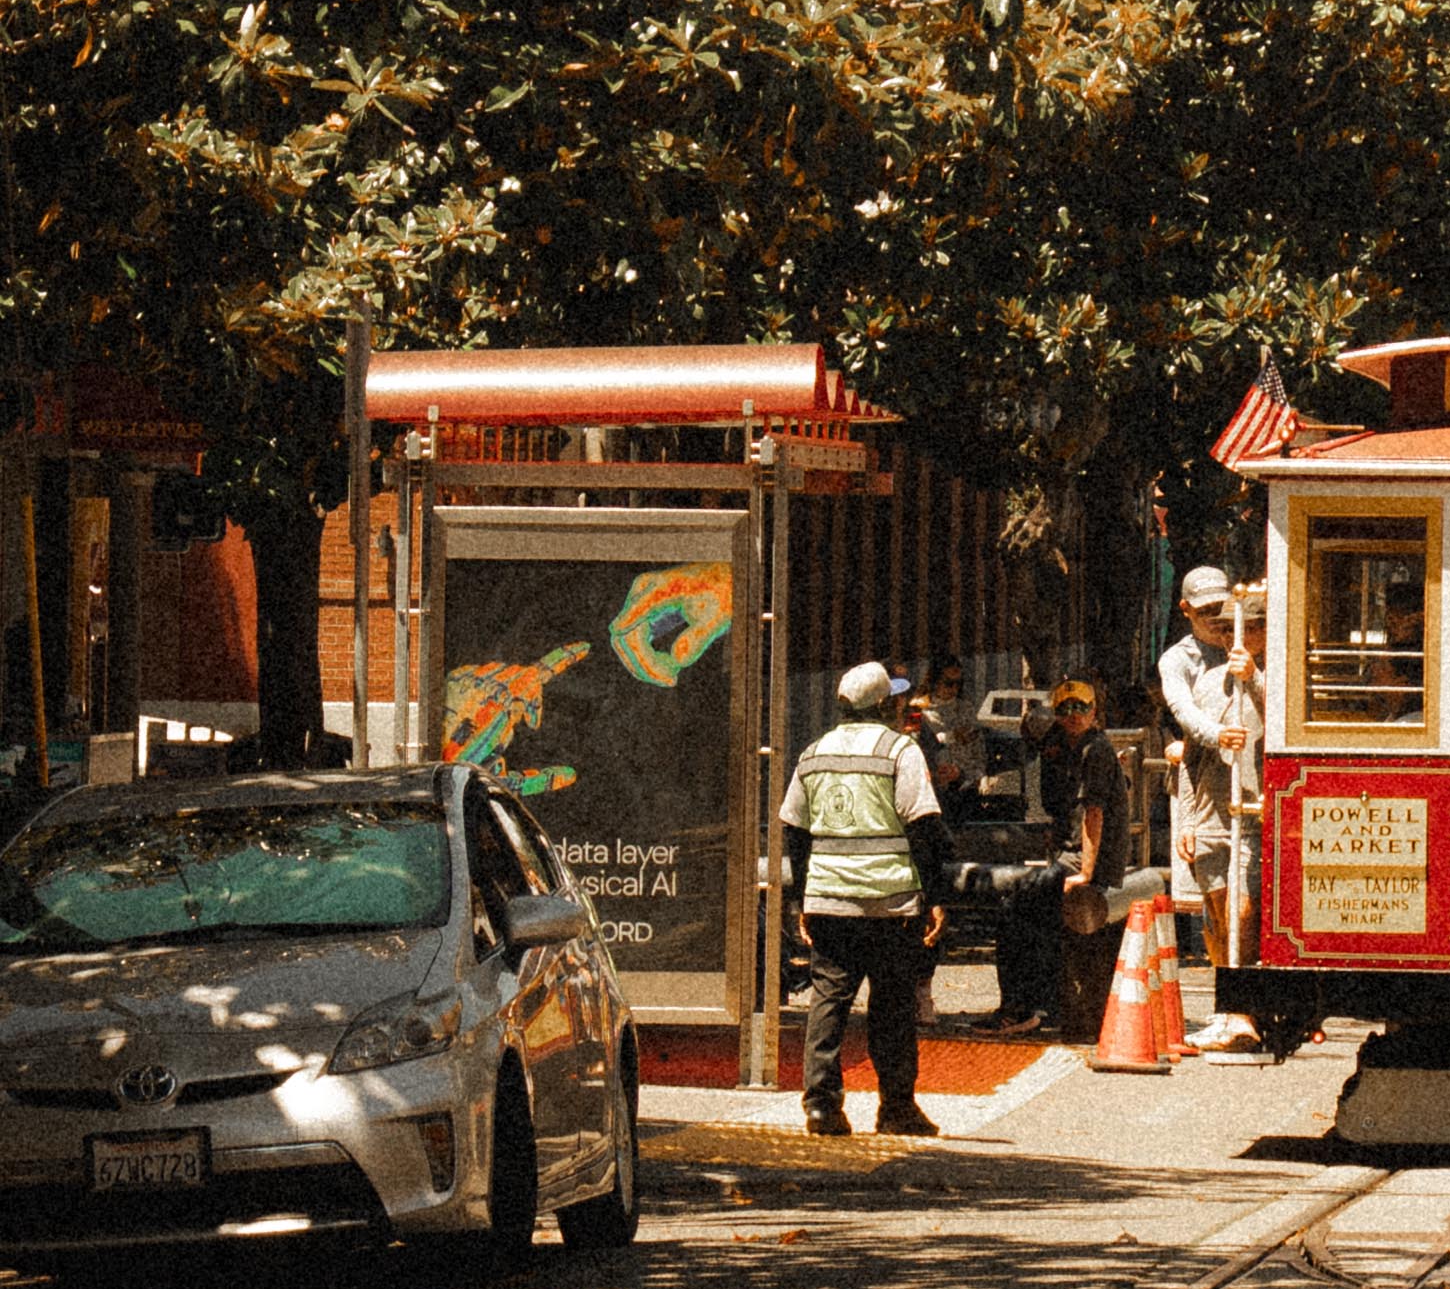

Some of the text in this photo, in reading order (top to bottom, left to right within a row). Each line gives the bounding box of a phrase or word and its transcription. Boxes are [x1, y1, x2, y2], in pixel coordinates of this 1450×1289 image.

[1311, 807, 1420, 823] POWELL
[1340, 825, 1393, 837] AND
[1308, 838, 1421, 854] MARKET
[616, 838, 680, 872] layer
[580, 869, 677, 897] sical AI
[1308, 875, 1337, 894] BAY
[1364, 875, 1421, 895] TAYLOR
[1318, 897, 1410, 911] FISHERMANS
[1340, 912, 1386, 925] WHARF
